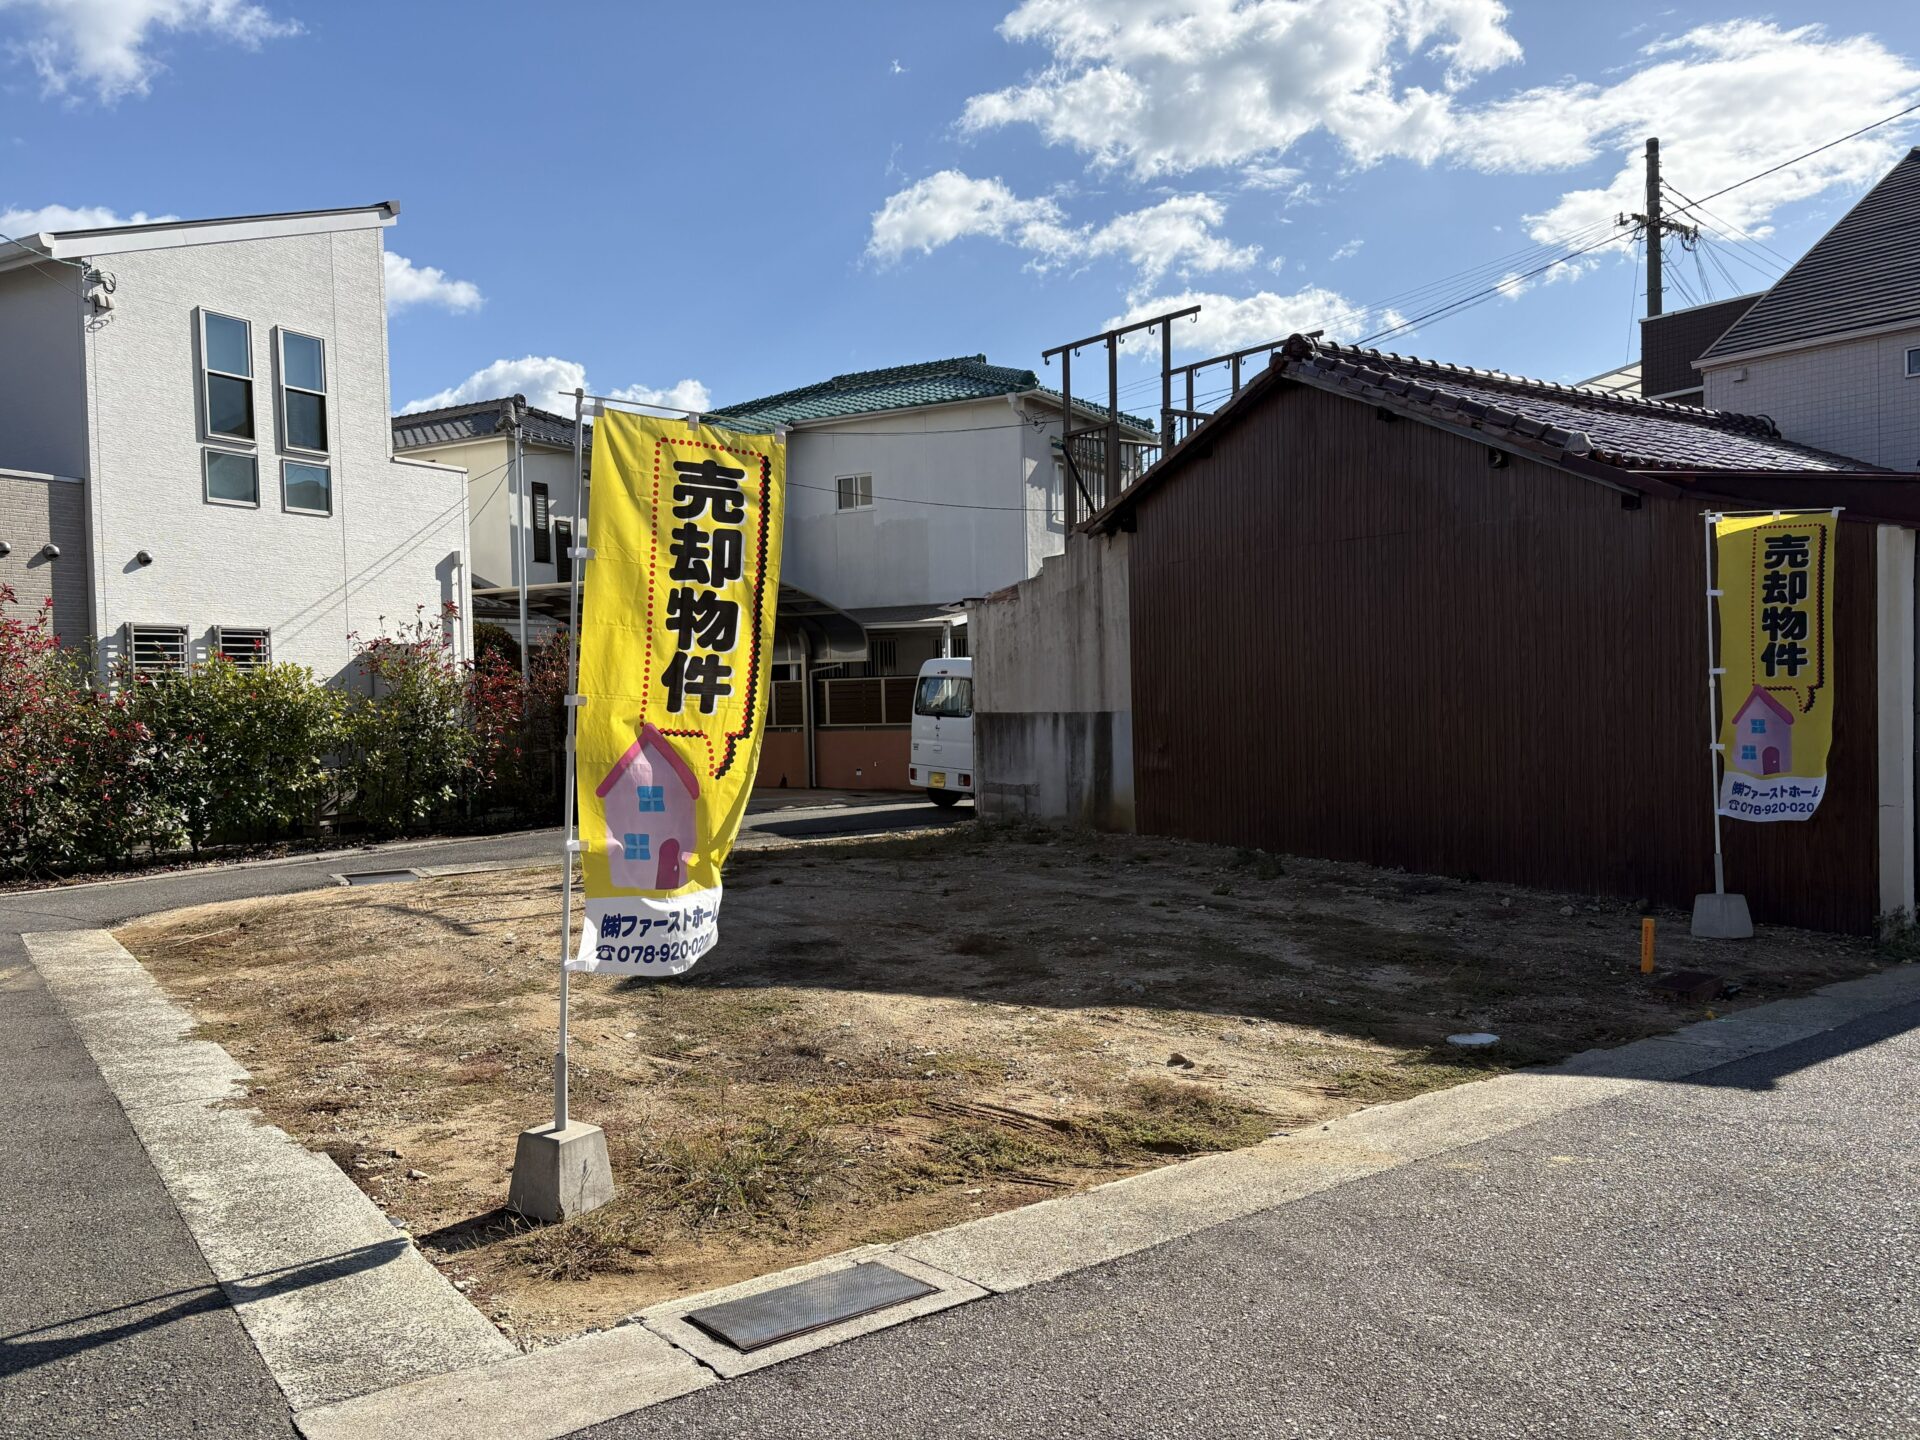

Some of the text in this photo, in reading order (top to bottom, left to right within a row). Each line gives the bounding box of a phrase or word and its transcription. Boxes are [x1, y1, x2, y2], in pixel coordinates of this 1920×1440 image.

[661, 459, 745, 714] 売却物件
[1761, 534, 1810, 677] 売却物件
